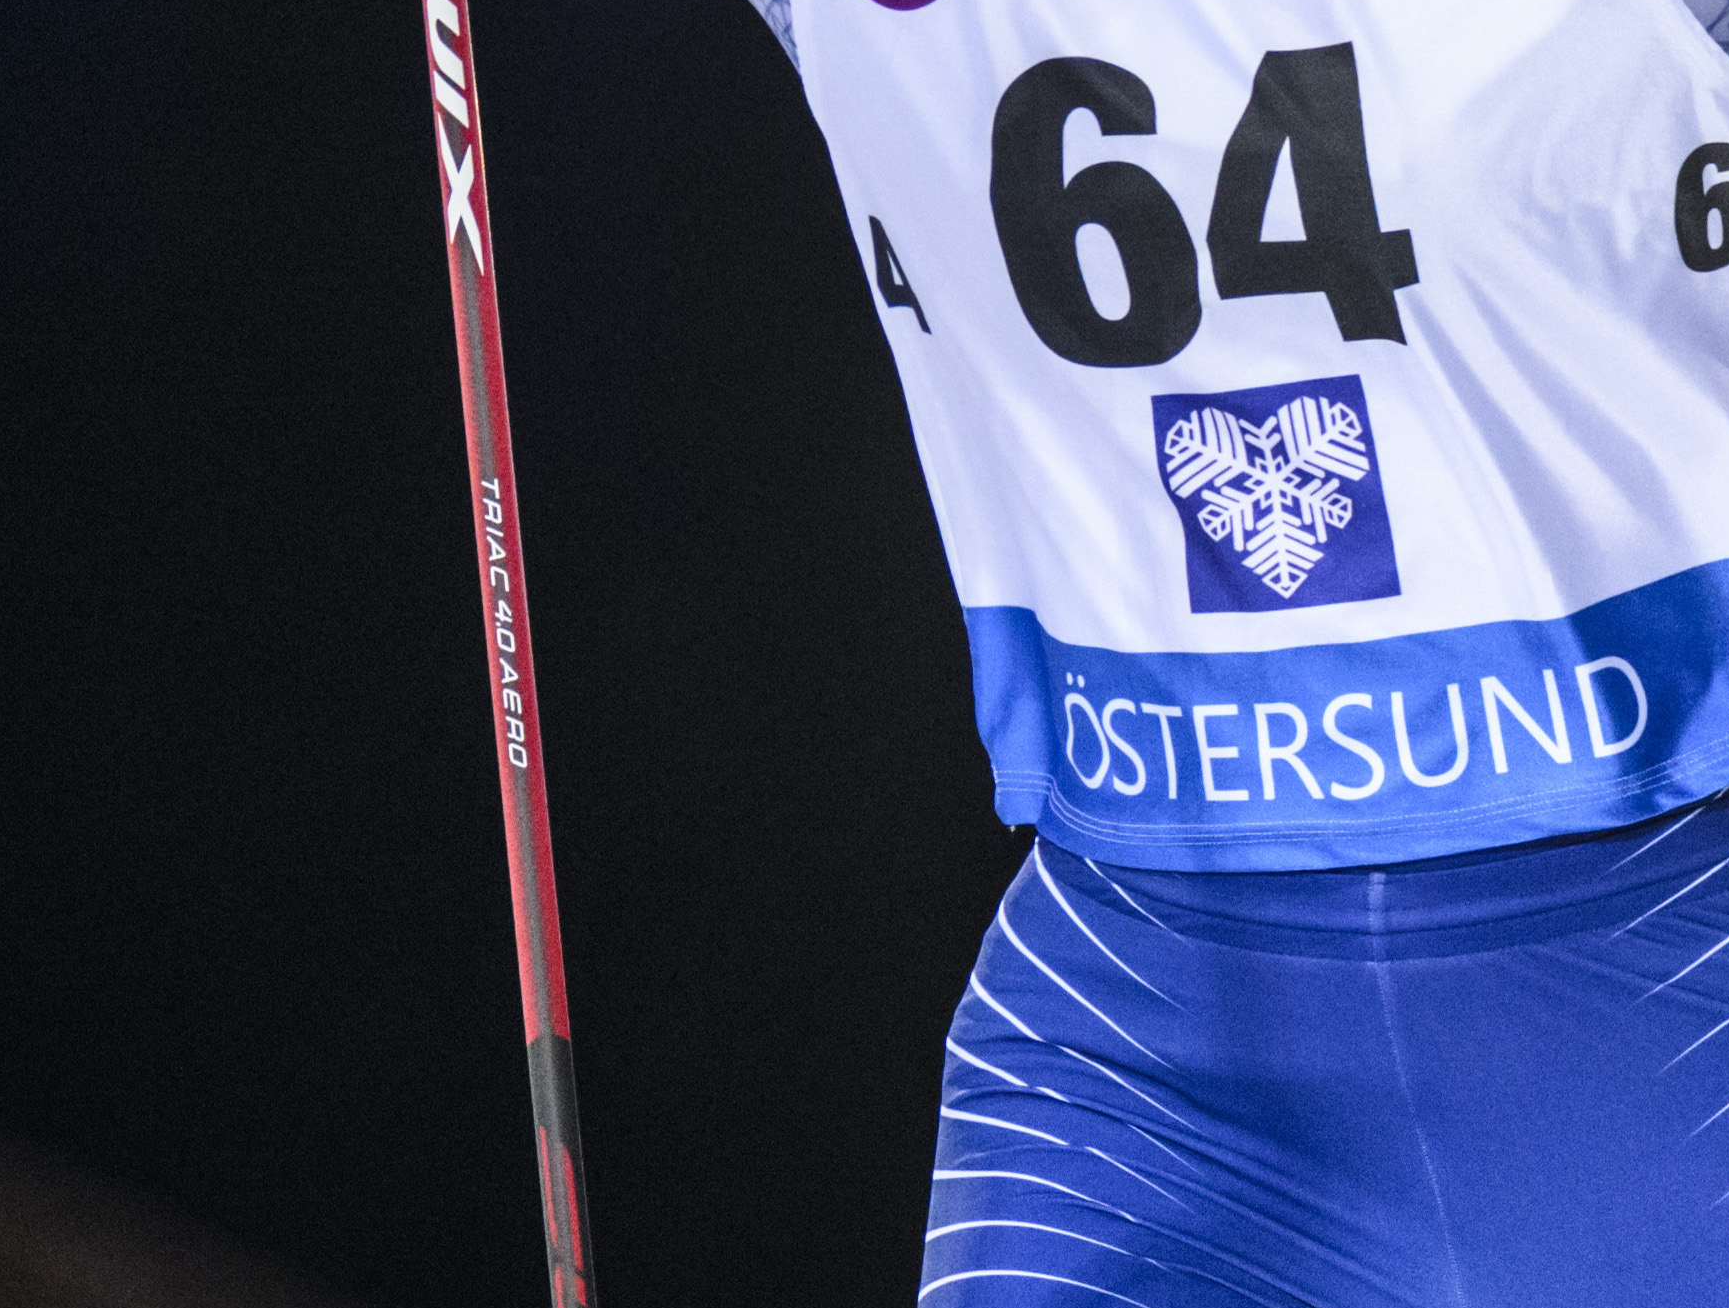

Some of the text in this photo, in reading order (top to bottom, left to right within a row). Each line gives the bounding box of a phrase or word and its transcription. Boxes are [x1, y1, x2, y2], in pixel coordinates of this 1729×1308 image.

[989, 40, 1420, 369] 64
[480, 477, 528, 769] TRIAC 4.0 AERO
[1063, 655, 1650, 804] ÖSTERSUND
